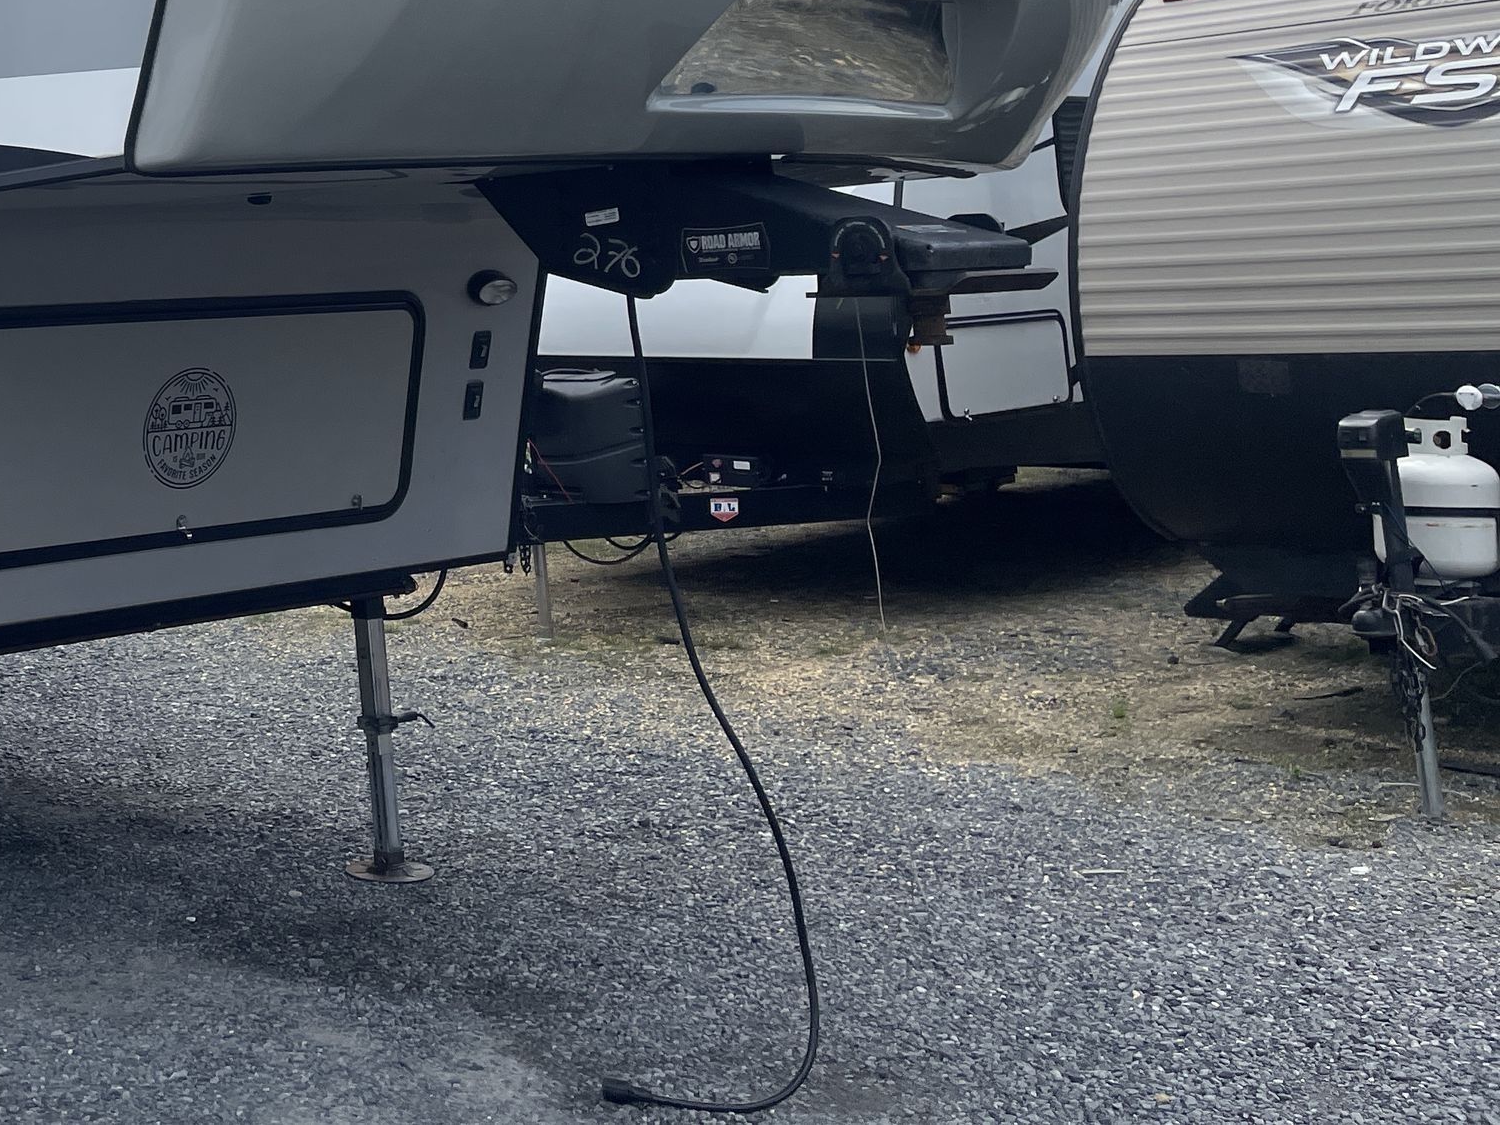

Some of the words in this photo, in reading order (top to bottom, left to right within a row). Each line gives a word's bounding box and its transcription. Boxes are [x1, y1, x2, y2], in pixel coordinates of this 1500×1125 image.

[701, 234, 726, 250] ROAD
[728, 231, 761, 248] ARMOR
[152, 429, 226, 457] CAMPING
[157, 458, 187, 480] FAVORITE
[188, 454, 217, 479] SEASON
